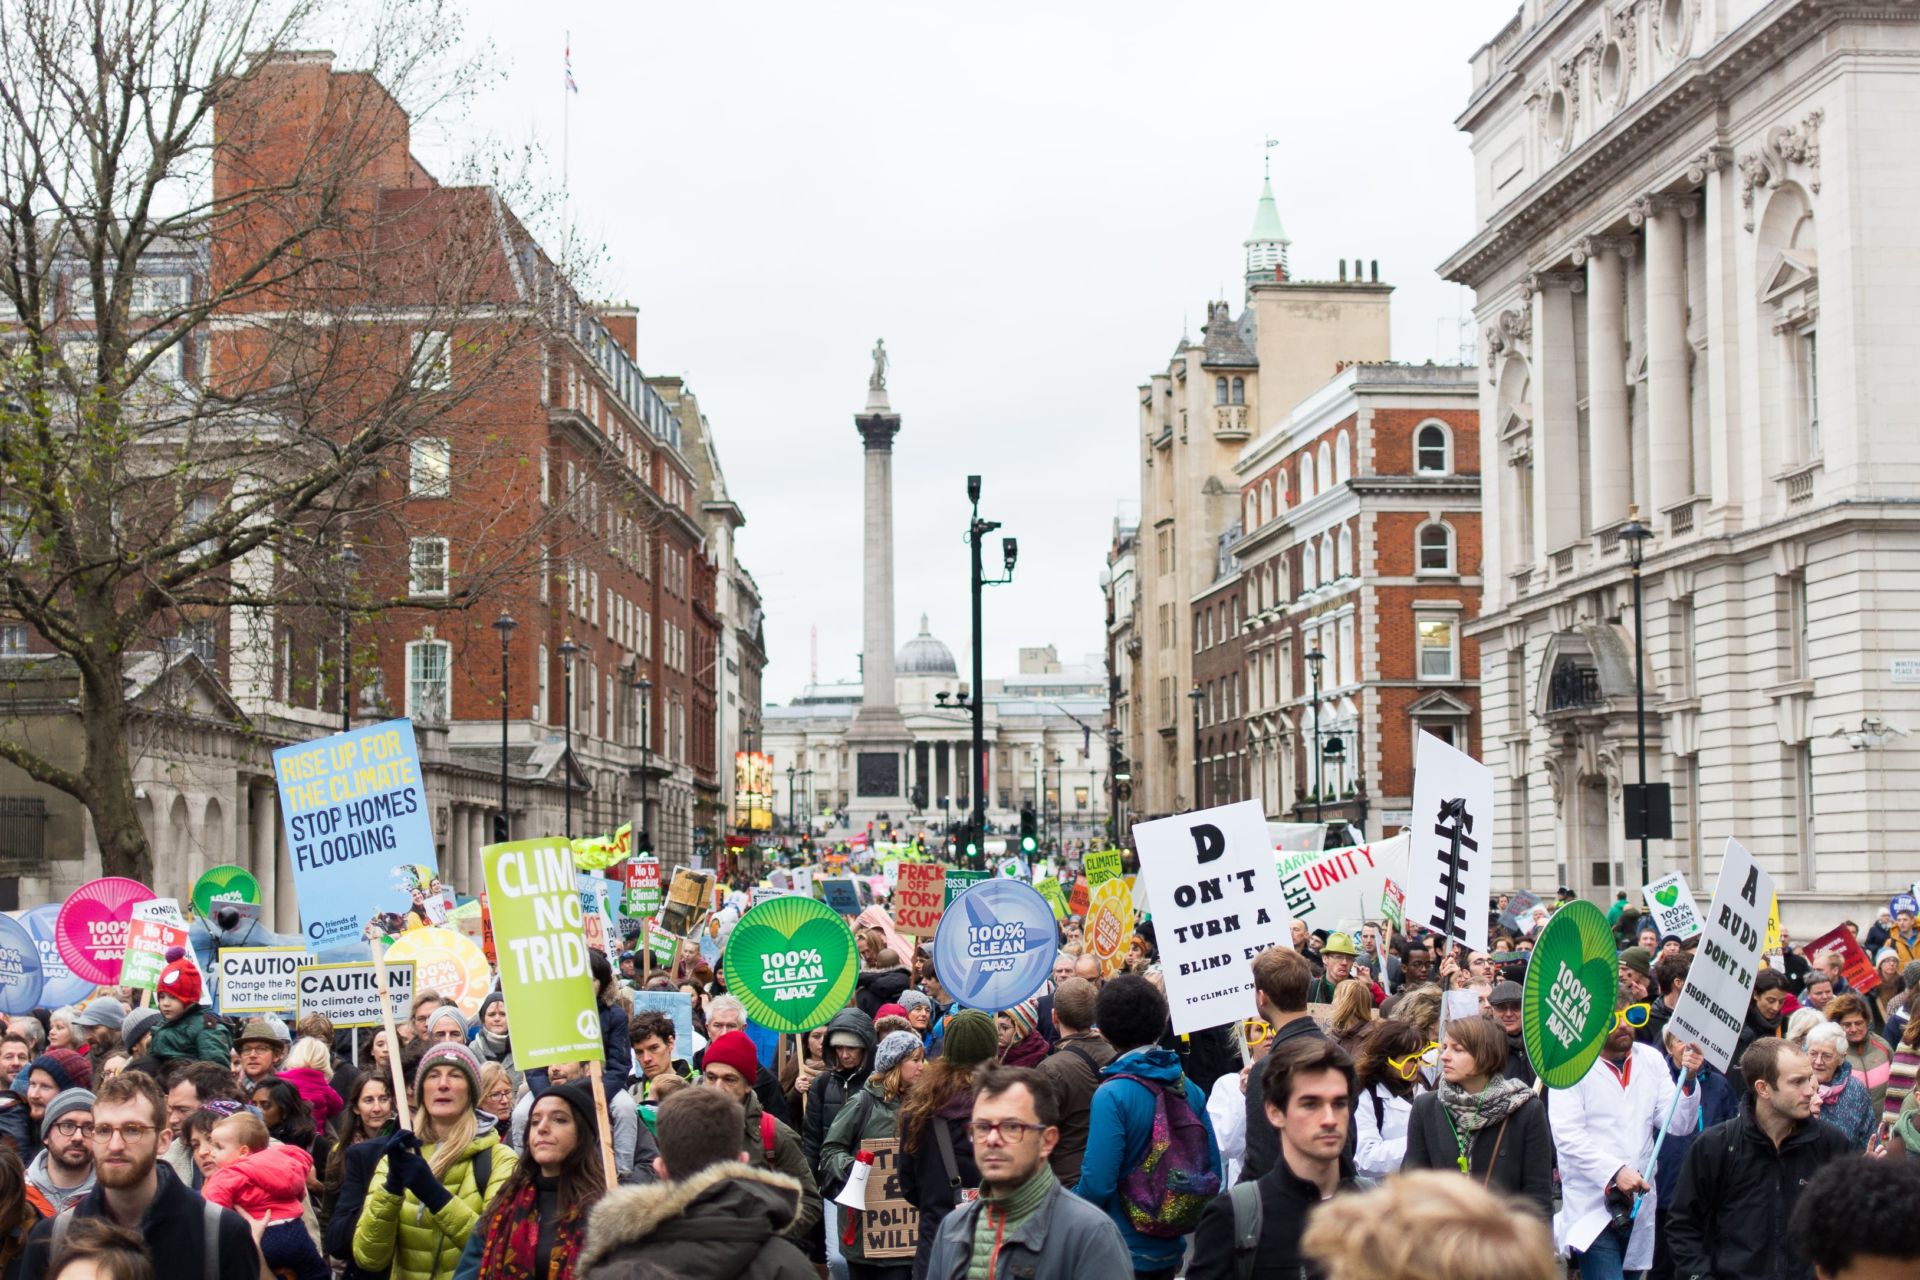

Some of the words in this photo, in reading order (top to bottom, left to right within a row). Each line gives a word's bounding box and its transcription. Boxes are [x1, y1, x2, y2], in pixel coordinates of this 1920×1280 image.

[281, 748, 330, 785] RISE
[331, 739, 360, 771] UP
[362, 730, 402, 763] FOR
[285, 779, 328, 813] THE
[329, 757, 416, 803] CLIMATE
[291, 806, 342, 841] STOP
[347, 787, 417, 829] HOMES
[295, 824, 397, 872] FLOODING
[1190, 824, 1226, 864] D
[635, 865, 646, 876] No
[648, 866, 655, 876] to
[898, 863, 945, 881] FRACK
[1086, 854, 1119, 870] CLIMATE
[1276, 851, 1322, 877] BARNE
[1304, 846, 1374, 892] UNITY
[496, 847, 578, 898] CLIM
[1089, 871, 1110, 884] JOBS
[630, 877, 659, 889] fracking
[908, 880, 930, 889] OFF
[945, 878, 967, 889] FOSSIL
[1174, 869, 1255, 908] ON'T
[1650, 876, 1677, 893] LONDON
[1741, 864, 1759, 907] A
[631, 889, 658, 900] Climate
[898, 891, 941, 907] TORY
[1280, 873, 1316, 918] LEFT
[534, 895, 584, 931] NO
[629, 900, 646, 914] jobs
[1661, 903, 1689, 920] 100%
[325, 917, 349, 928] friends
[326, 926, 338, 935] the
[339, 922, 358, 932] earth
[897, 909, 942, 928] SCUM
[1103, 908, 1121, 932] 100%
[1174, 914, 1241, 944] TURN
[1257, 908, 1271, 925] A
[1664, 911, 1693, 927] CLEAN
[1718, 904, 1758, 952] RUDD
[143, 923, 159, 938] No
[163, 927, 174, 943] to
[968, 922, 1025, 944] 100%
[1100, 918, 1118, 942] CLEAN
[967, 939, 1025, 958] CLEAN
[760, 948, 822, 970] 100%
[1180, 953, 1232, 976] BLIND
[1704, 939, 1738, 976] DON'T
[1738, 969, 1752, 990] BE
[762, 964, 823, 984] CLEAN
[227, 980, 265, 991] Change
[268, 979, 282, 988] the
[285, 979, 296, 987] Po
[1556, 960, 1593, 1013] 100%
[231, 993, 251, 1002] NOT
[254, 992, 268, 1001] the
[271, 992, 296, 1001] clima
[302, 998, 318, 1007] No
[321, 995, 364, 1007] climate
[367, 993, 410, 1005] chnge
[1186, 997, 1199, 1005] TO
[1200, 986, 1240, 1002] CLIMATE
[358, 1006, 398, 1017] ahe!
[1550, 982, 1587, 1033] CLEAN
[1685, 982, 1711, 1011] SHORT
[1710, 1002, 1741, 1034] SIGHTED
[1700, 1035, 1710, 1046] AND
[867, 1208, 919, 1229] POLIT
[867, 1230, 919, 1250] WILL
